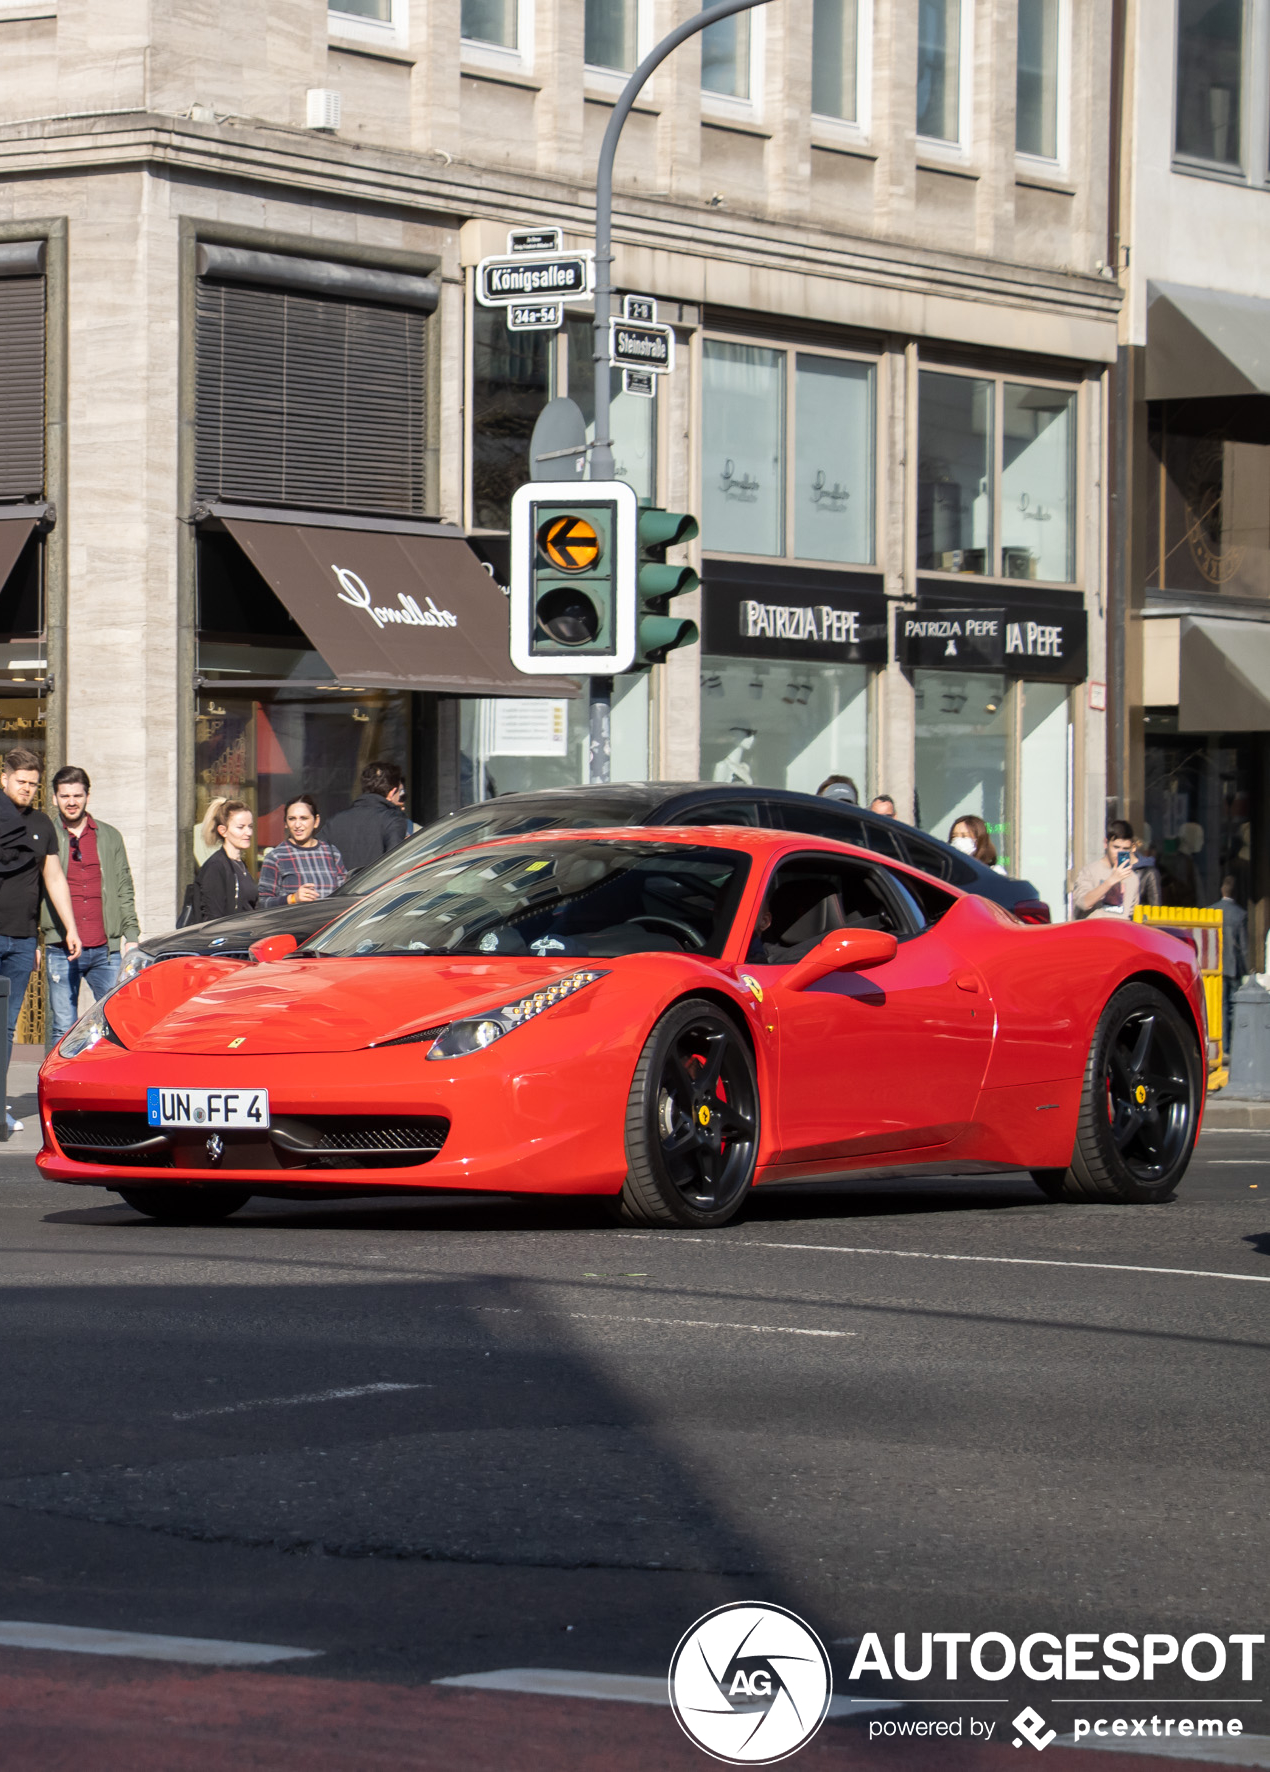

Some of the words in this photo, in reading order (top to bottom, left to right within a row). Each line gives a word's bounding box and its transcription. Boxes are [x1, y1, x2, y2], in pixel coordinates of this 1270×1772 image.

[491, 266, 575, 292] Königsallee
[514, 307, 556, 324] 34a-54
[617, 331, 666, 359] Steinstraße
[330, 564, 458, 629] Pomellato
[743, 600, 818, 640] PATRIZIA
[820, 605, 860, 643] PEPE
[904, 620, 962, 637] PATRIZIA
[965, 619, 998, 637] PEPE
[1027, 621, 1063, 657] PEPE
[151, 1110, 158, 1119] D
[161, 1093, 191, 1121] UN
[207, 1094, 240, 1122] FF
[246, 1095, 262, 1123] 4
